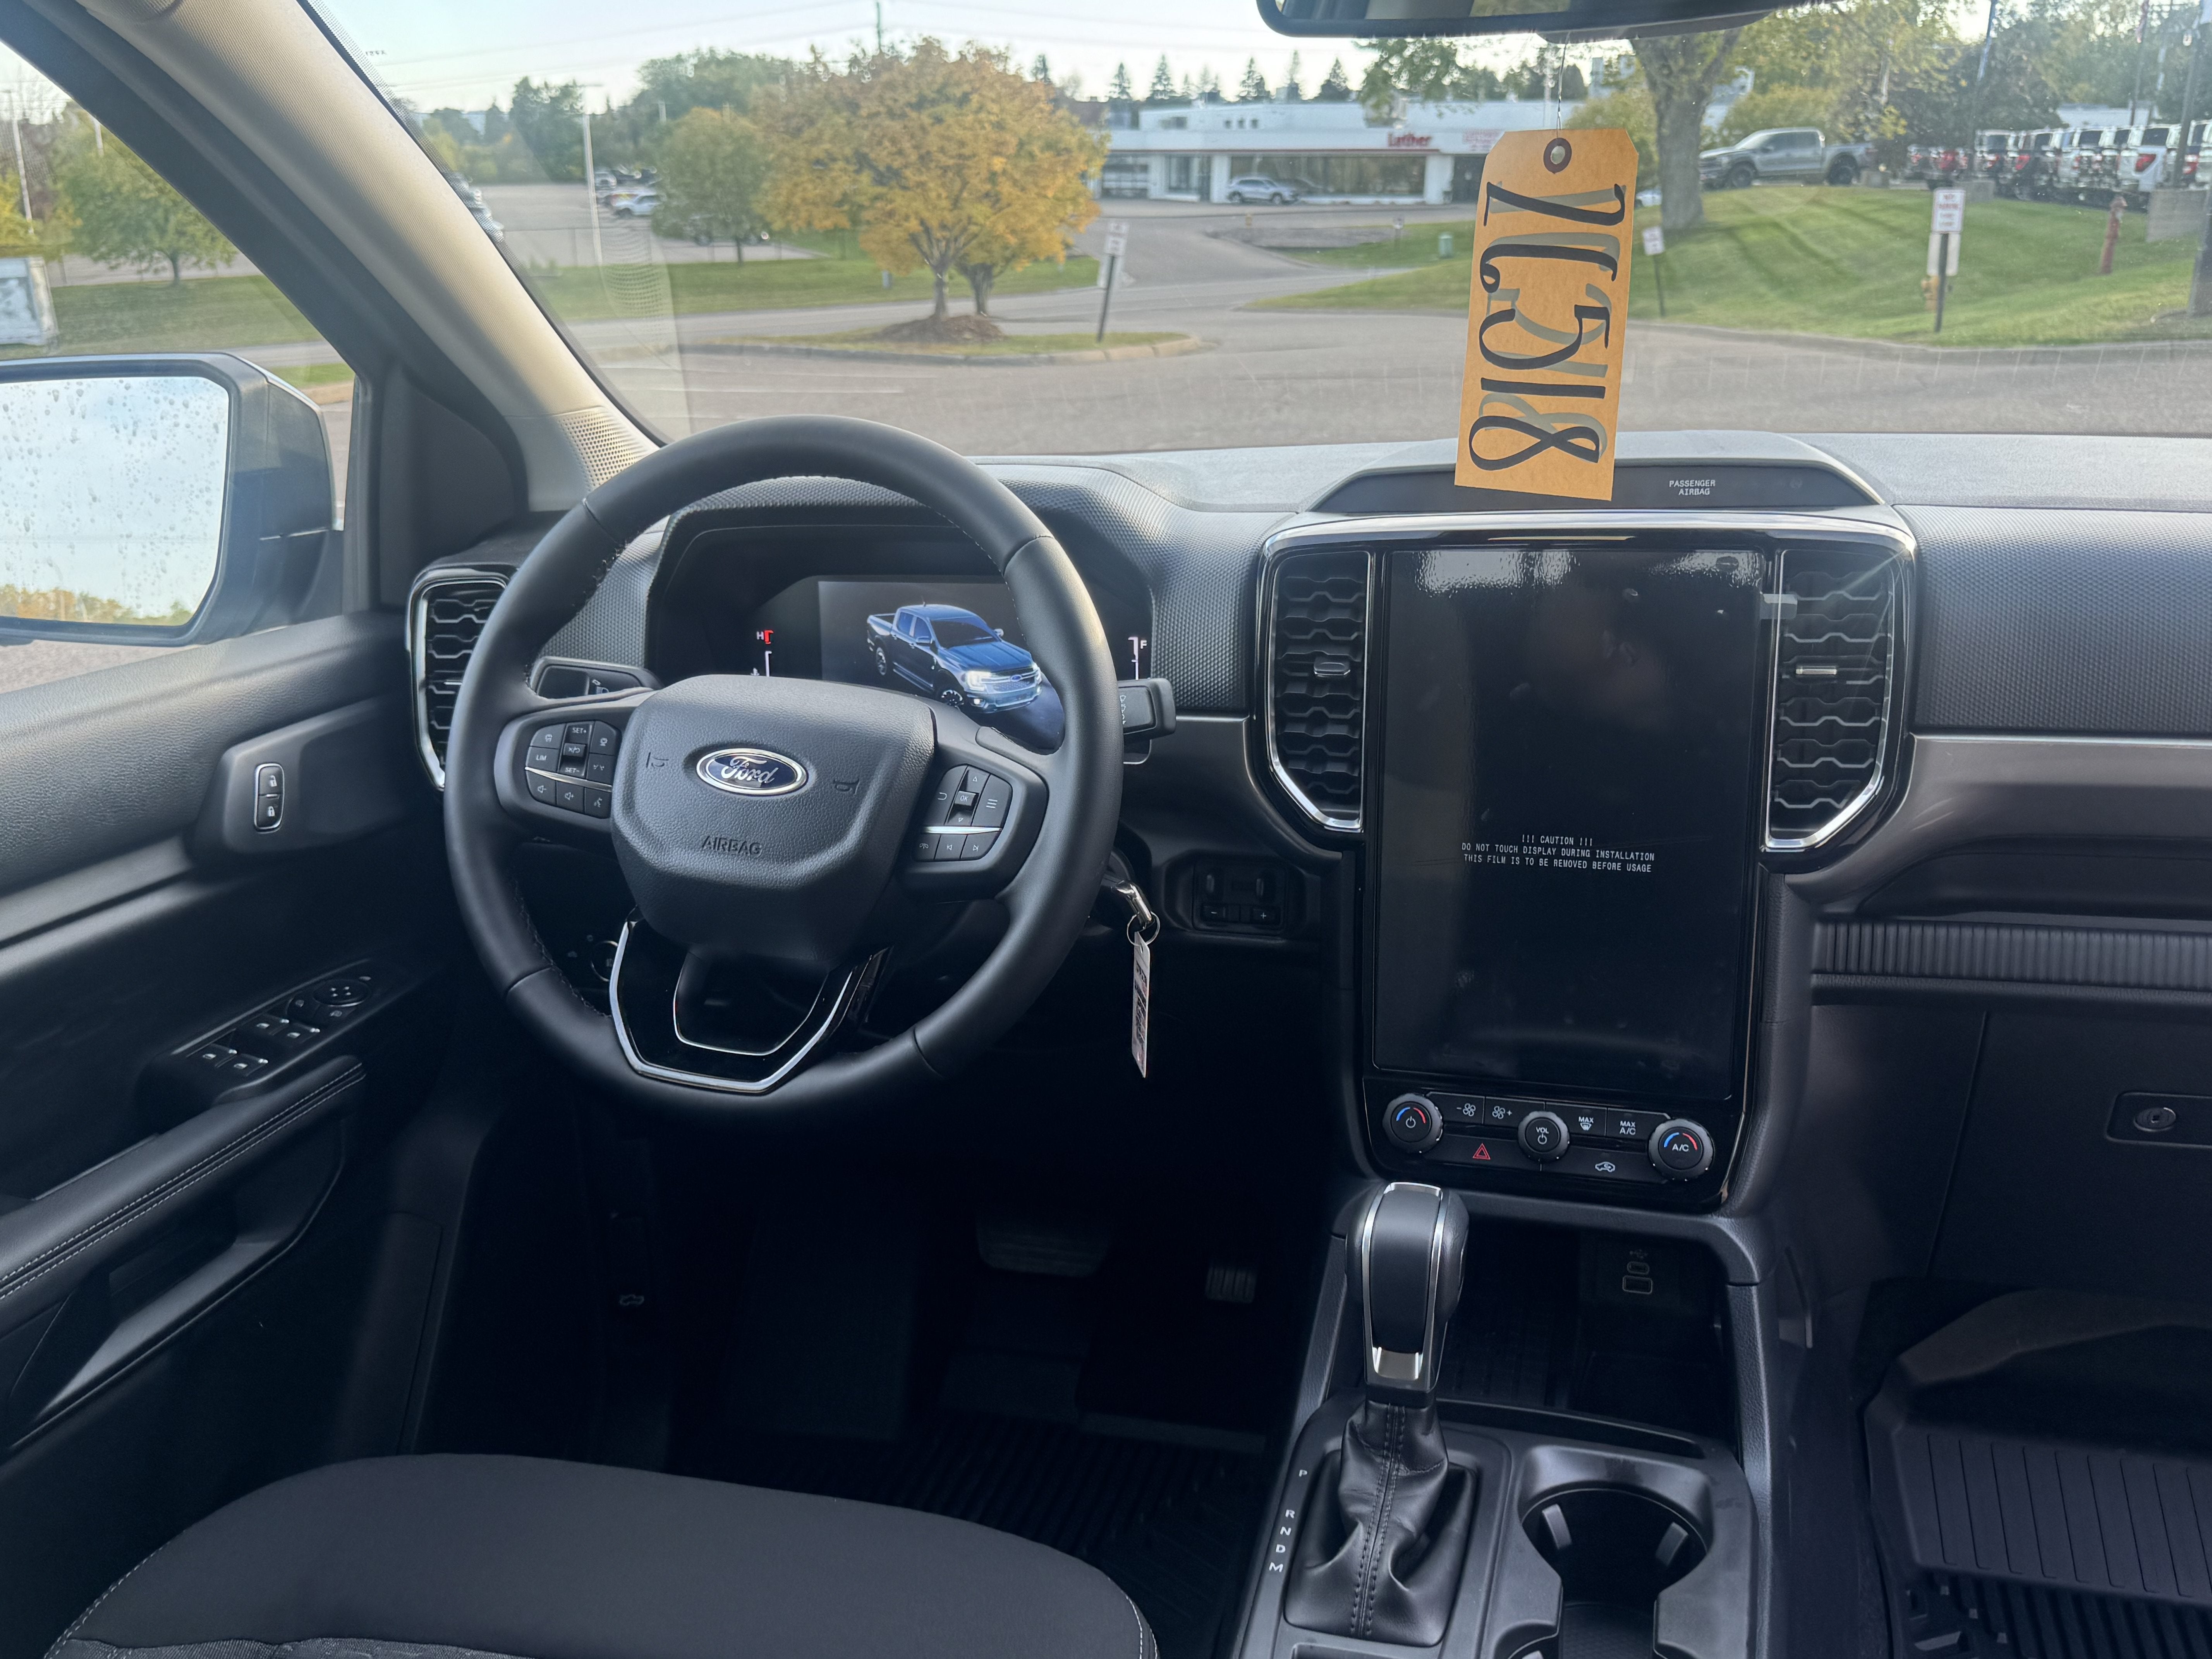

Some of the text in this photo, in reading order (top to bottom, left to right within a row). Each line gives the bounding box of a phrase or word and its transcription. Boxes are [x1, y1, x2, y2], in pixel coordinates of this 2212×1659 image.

[1140, 640, 1147, 649] F
[721, 756, 779, 783] Ford
[702, 835, 762, 855] AIRBAG
[1540, 835, 1574, 845] CAUTION
[1462, 842, 1655, 861] DO NOT TOUCH DISPLAY DURING INSTALLATION
[1464, 854, 1652, 872] THIS FILM IS TO BE REMOVED BEFORE USAGE
[1620, 1127, 1636, 1135] A/C
[1672, 1143, 1689, 1152] A/C
[1285, 1509, 1295, 1519] R
[1280, 1526, 1292, 1536] N
[1275, 1544, 1286, 1553] D
[1269, 1562, 1284, 1573] M
